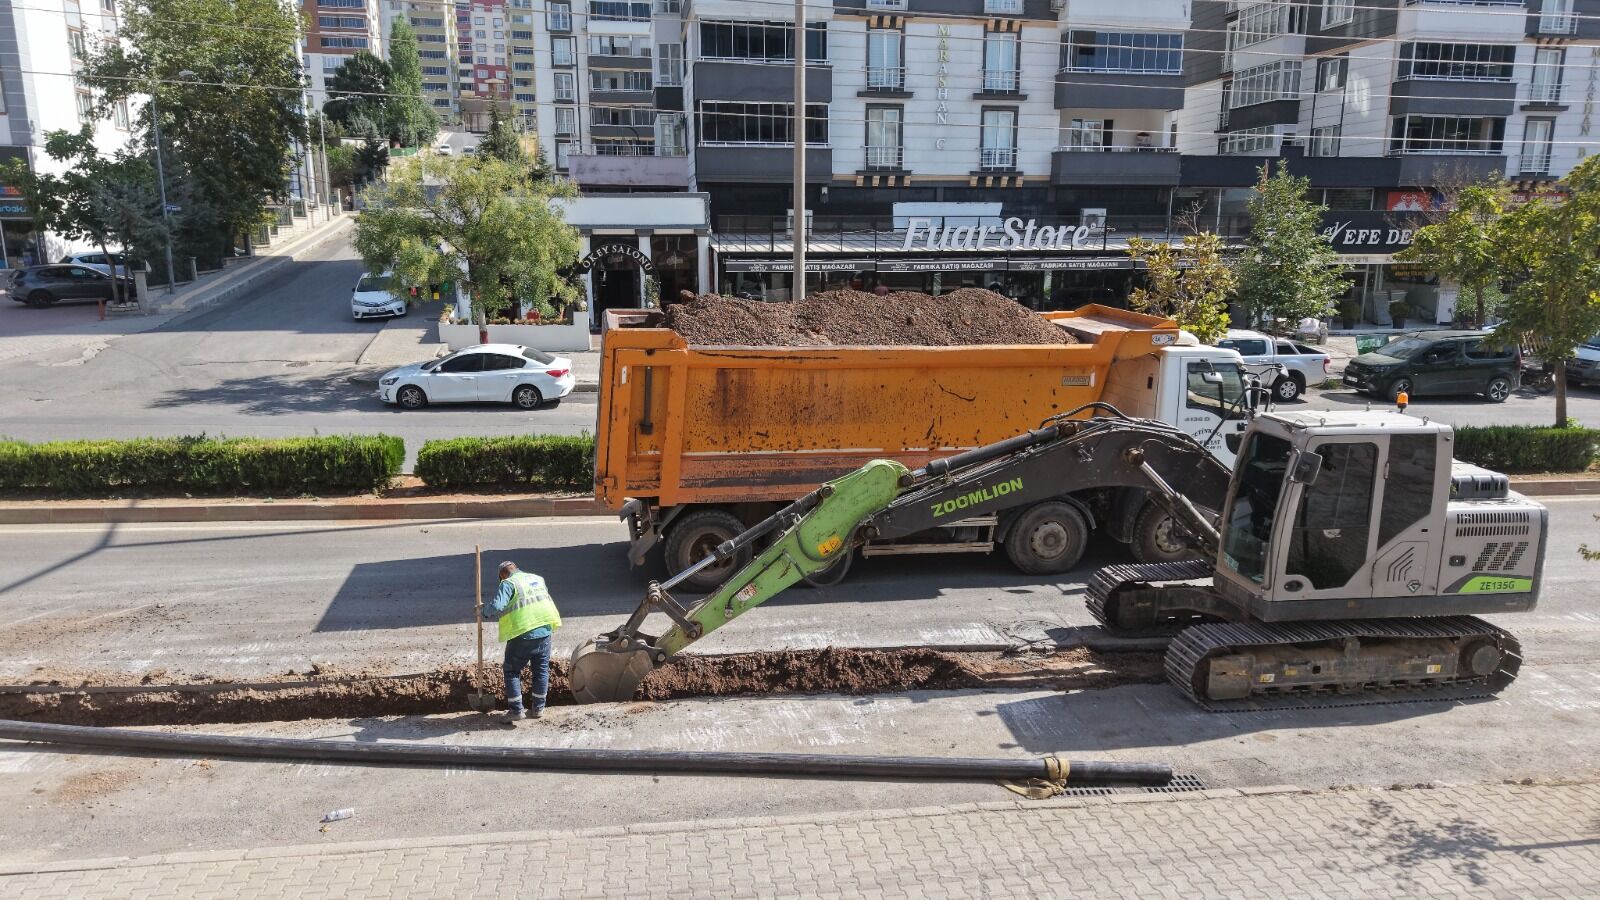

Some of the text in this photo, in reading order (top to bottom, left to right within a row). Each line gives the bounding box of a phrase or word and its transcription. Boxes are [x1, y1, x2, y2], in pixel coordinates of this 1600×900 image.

[903, 216, 1090, 250] Fuar Store
[1342, 229, 1414, 245] EFE DE
[582, 245, 609, 268] OKEY
[611, 244, 653, 271] SALONU
[930, 477, 1024, 518] ZOOMLION
[1479, 580, 1516, 591] ZE135G
